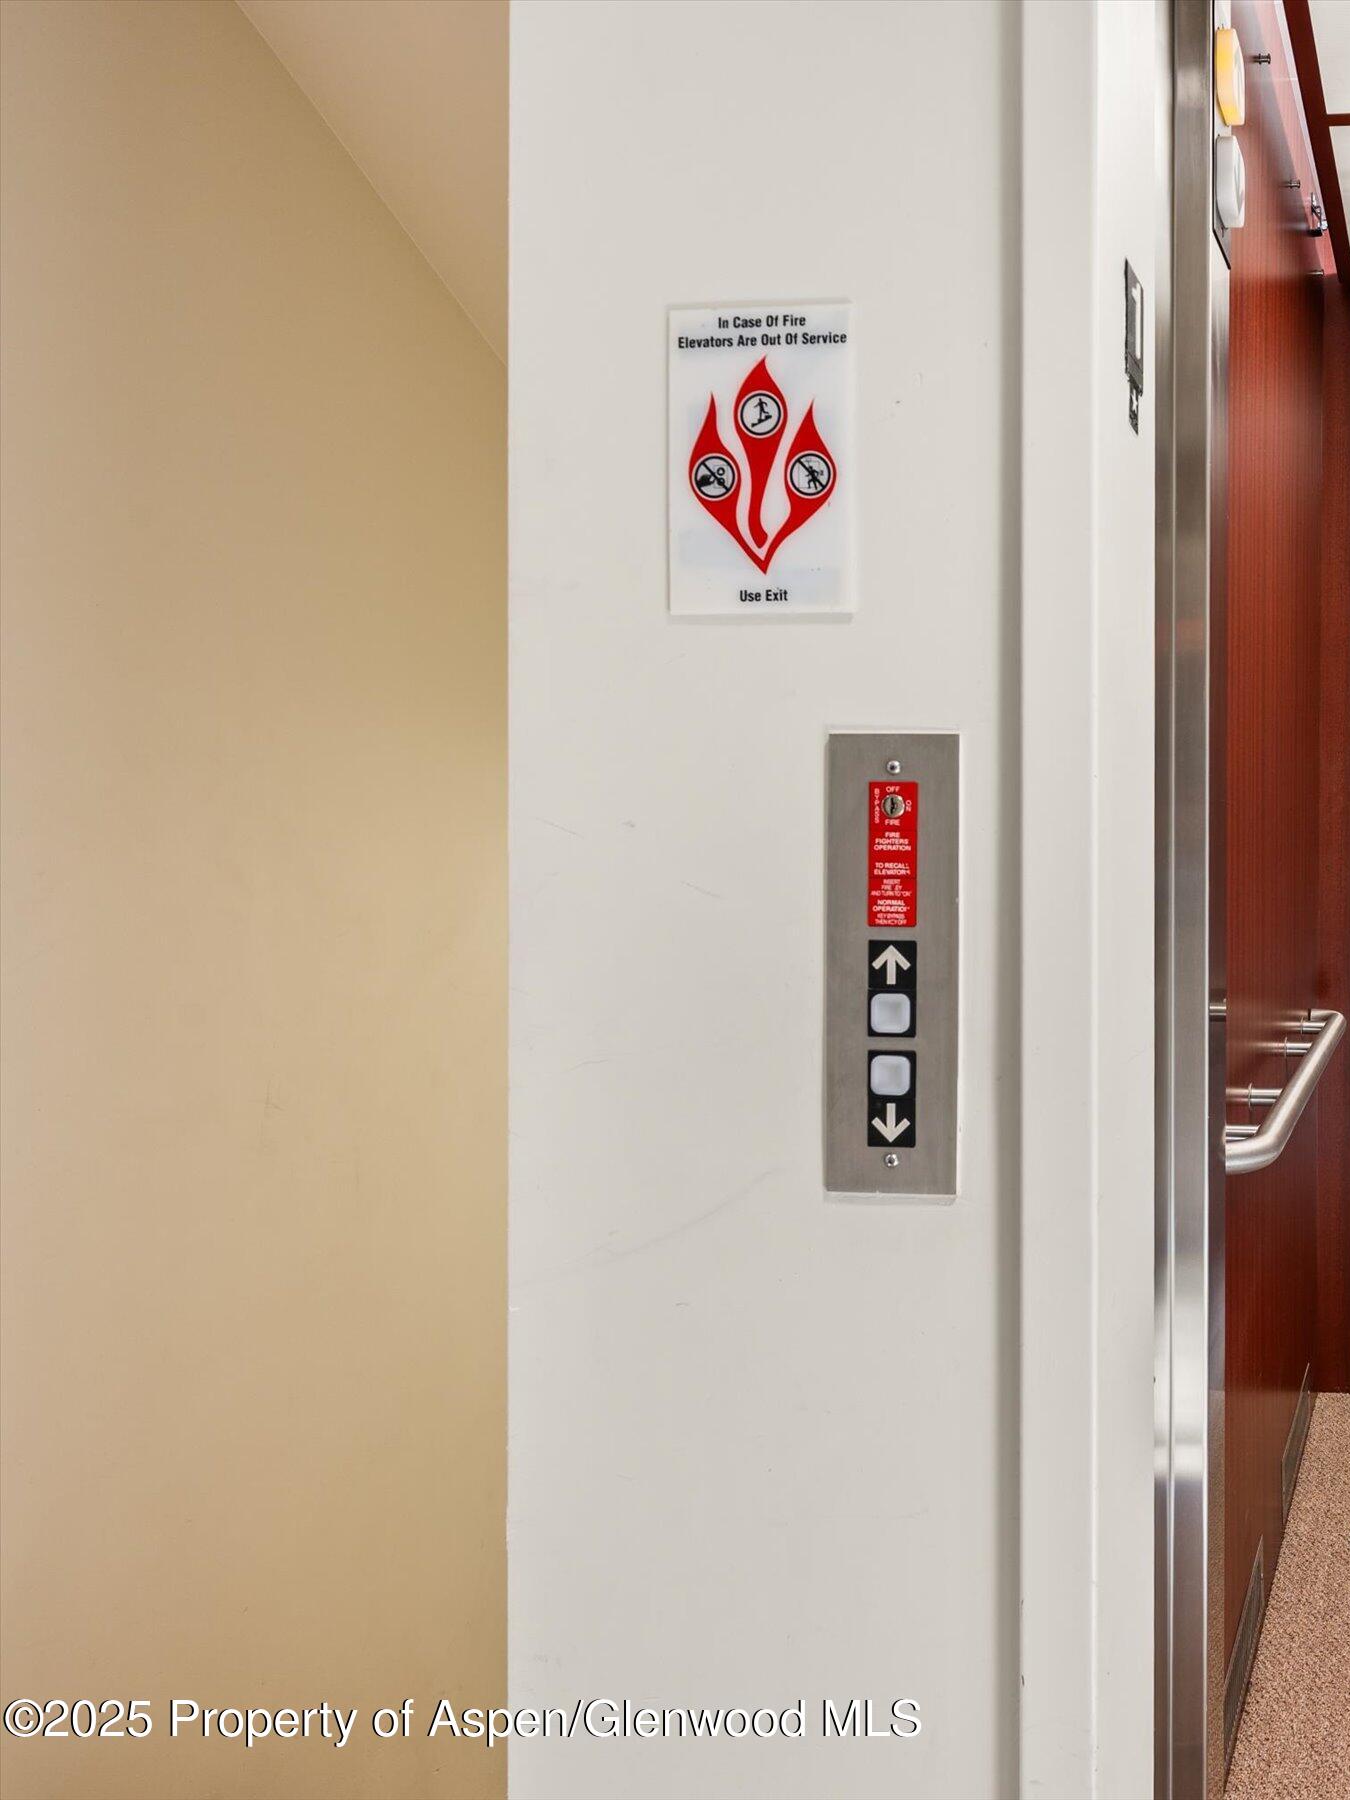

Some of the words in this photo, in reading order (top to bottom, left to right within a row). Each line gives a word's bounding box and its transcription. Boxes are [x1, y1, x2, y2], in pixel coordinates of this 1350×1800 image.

[718, 317, 729, 329] In
[733, 316, 762, 328] Case
[766, 315, 779, 328] Of
[783, 314, 806, 327] Fire
[678, 336, 733, 349] Elevators
[737, 334, 757, 347] Are
[761, 333, 782, 346] Out
[785, 332, 798, 345] Of
[801, 332, 847, 345] Service
[739, 589, 762, 602] Use
[766, 589, 788, 602] Exit
[885, 785, 900, 793] OFF
[884, 818, 900, 826] FIRE
